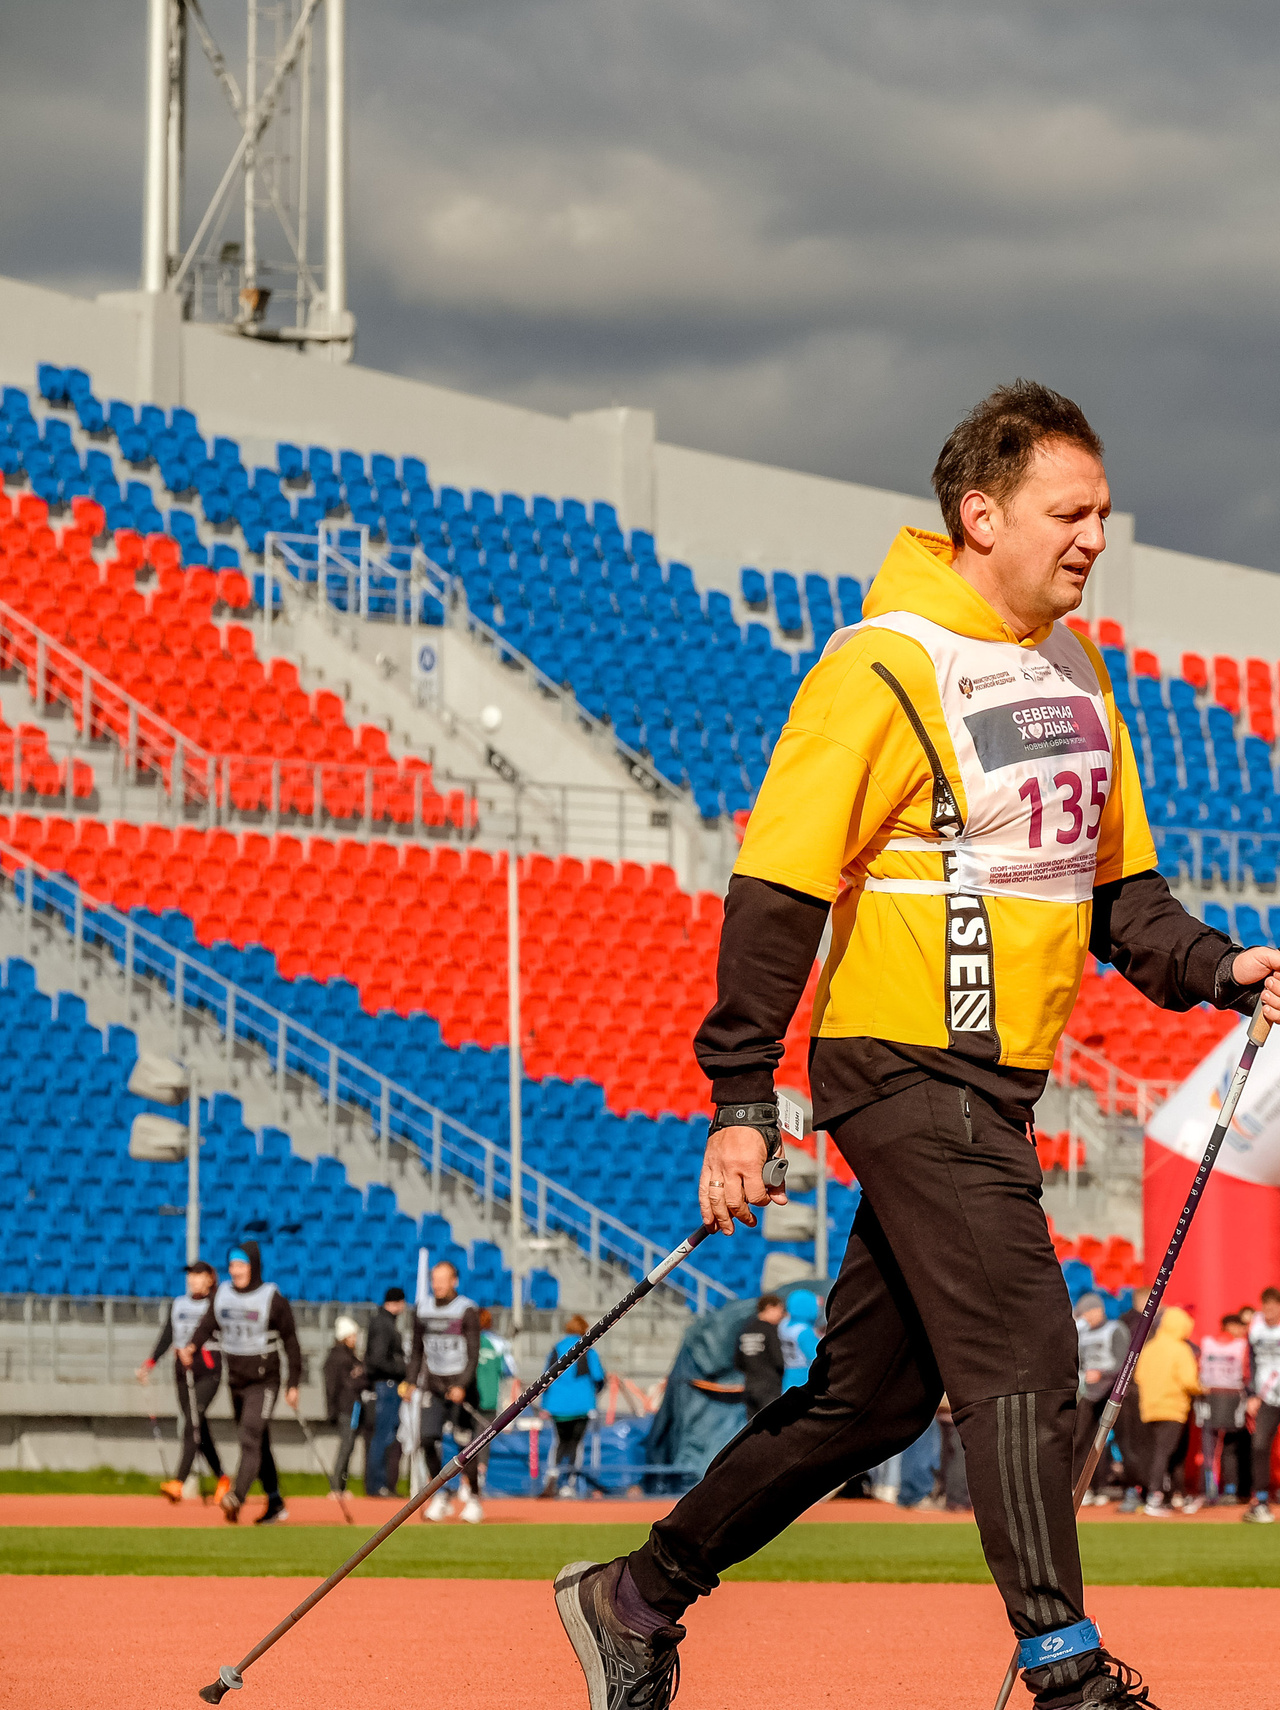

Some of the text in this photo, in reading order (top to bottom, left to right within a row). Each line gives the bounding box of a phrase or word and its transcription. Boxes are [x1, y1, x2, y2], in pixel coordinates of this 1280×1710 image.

[1012, 705, 1074, 725] СЕВЕРНАЯ
[1024, 740, 1049, 751] НОВЫЙ
[1050, 738, 1070, 747] ОБРАЗ
[1018, 767, 1108, 849] 135
[1143, 1143, 1216, 1318] НОВЫЙ ОБРАЗ ЖИЗНИ
